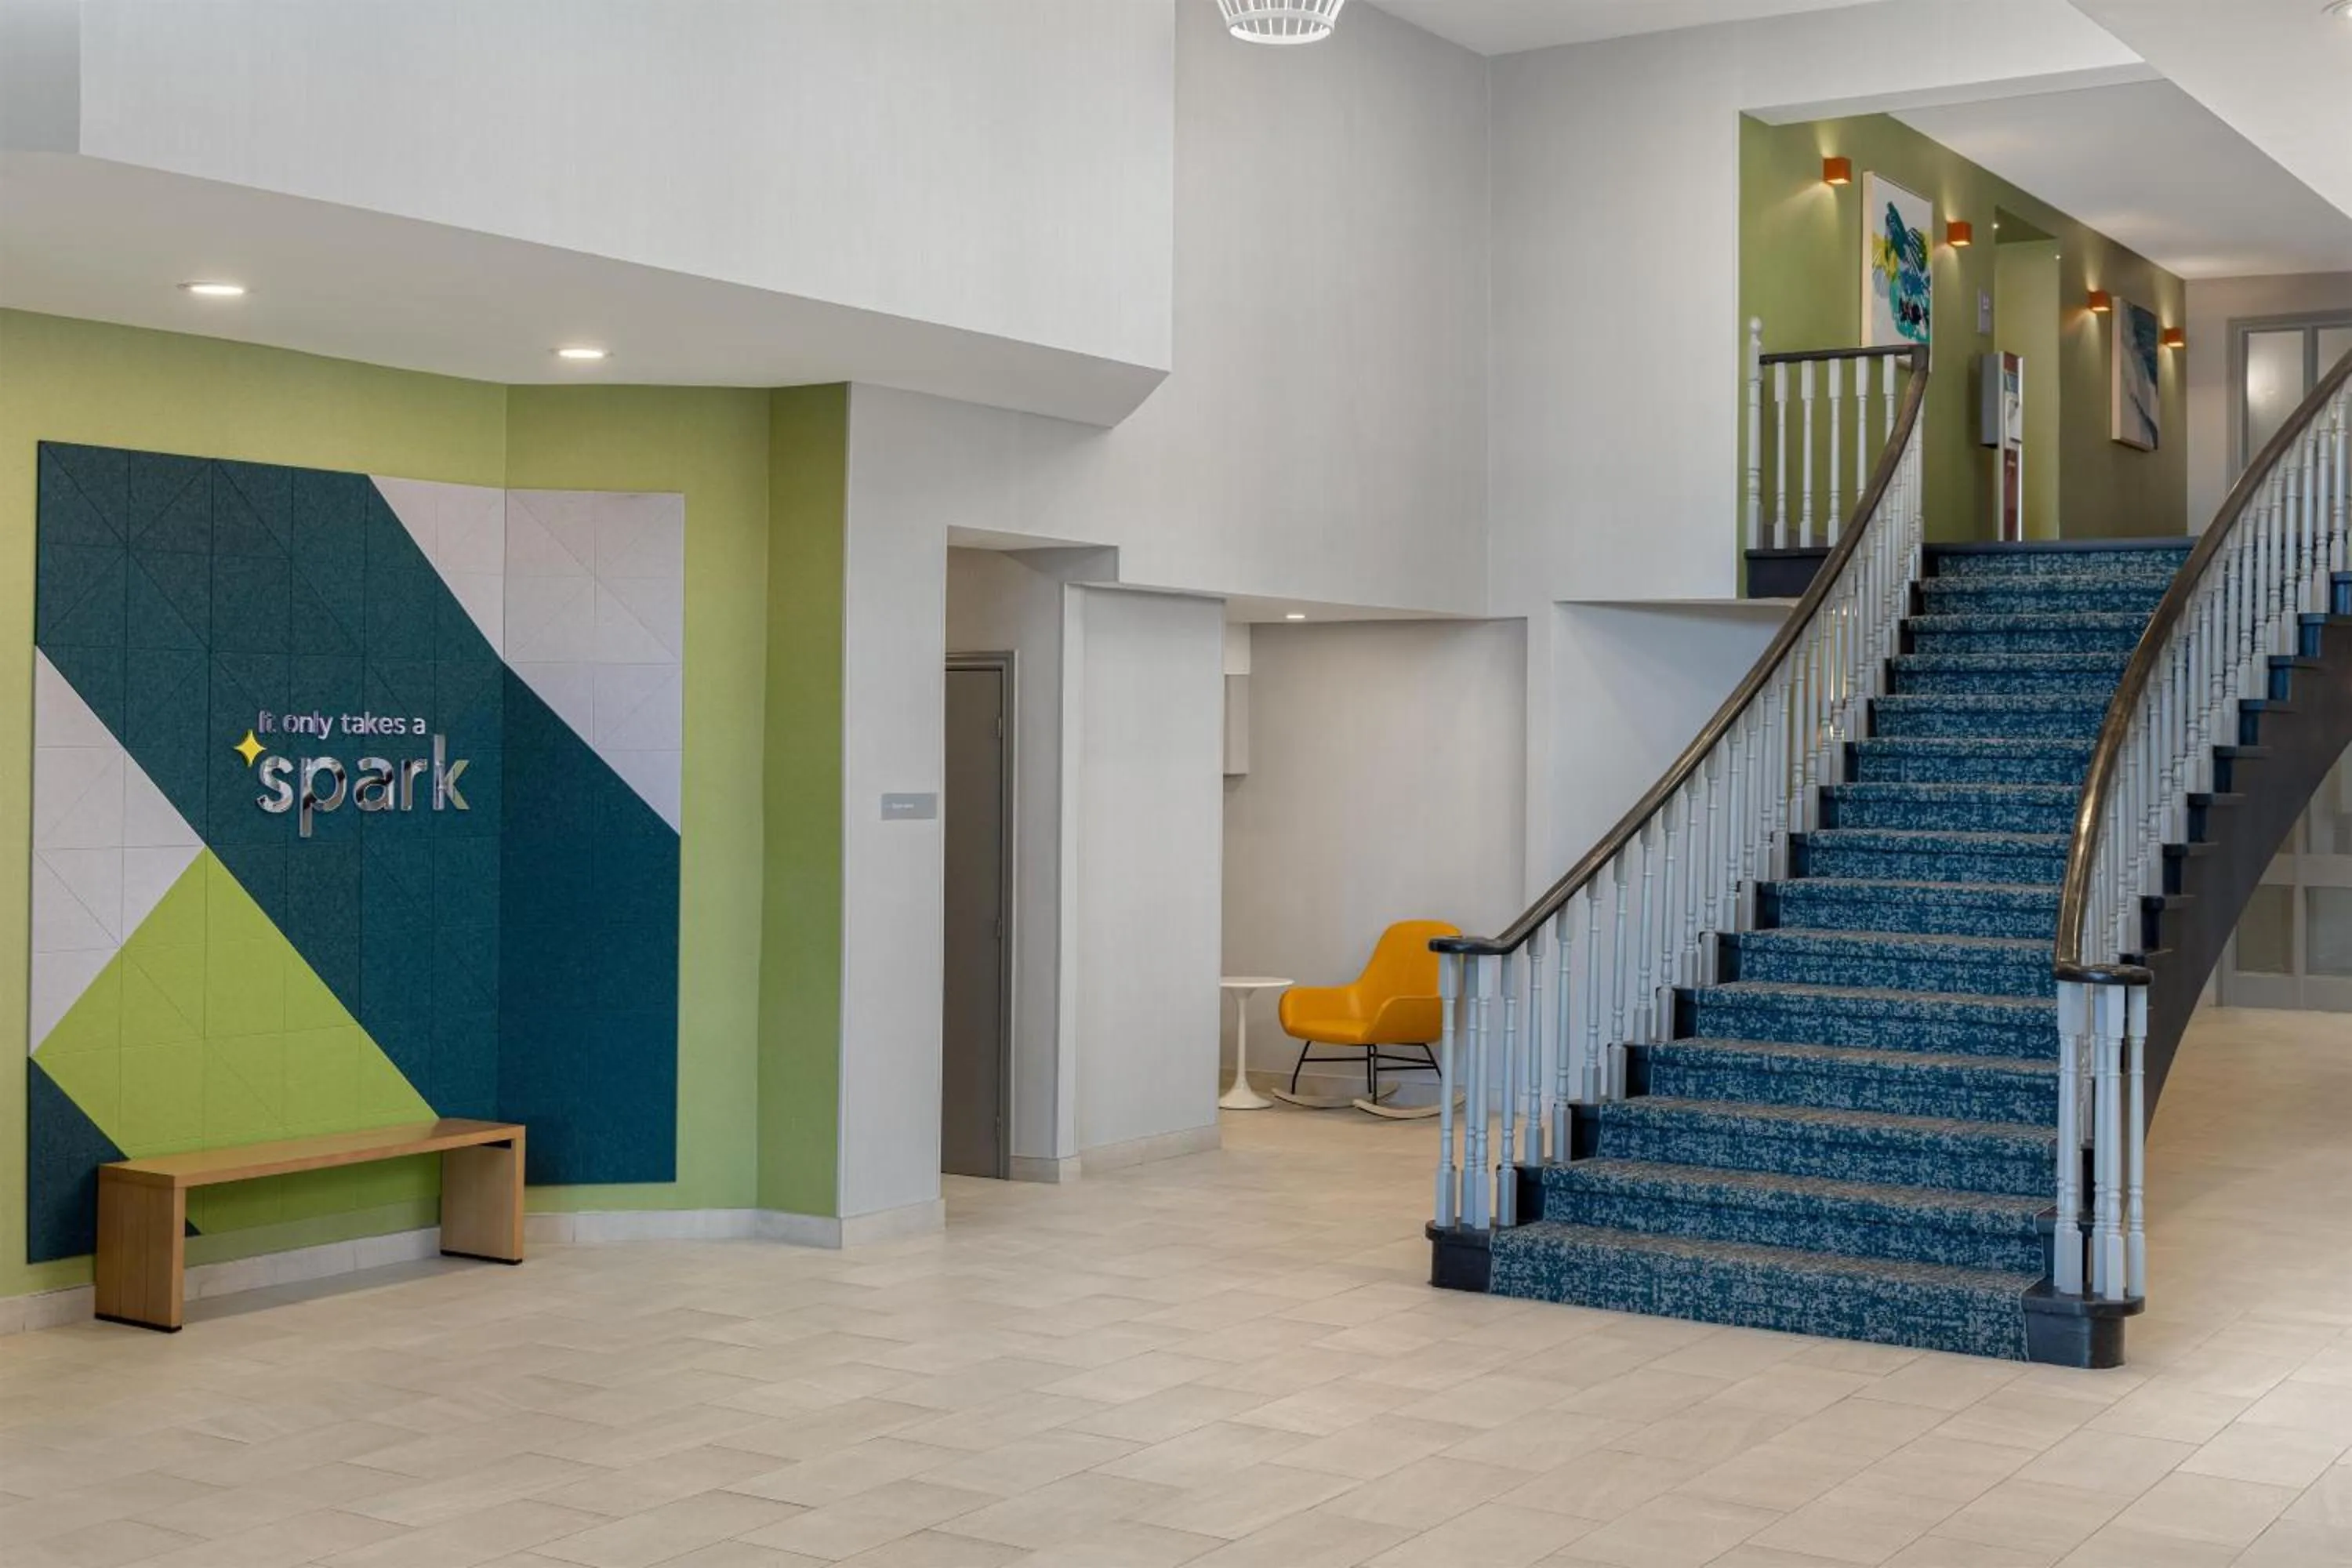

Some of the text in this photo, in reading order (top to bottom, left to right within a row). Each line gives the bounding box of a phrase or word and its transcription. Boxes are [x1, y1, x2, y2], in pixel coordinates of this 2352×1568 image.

[258, 710, 426, 739] It only takes a
[256, 734, 470, 837] spark
